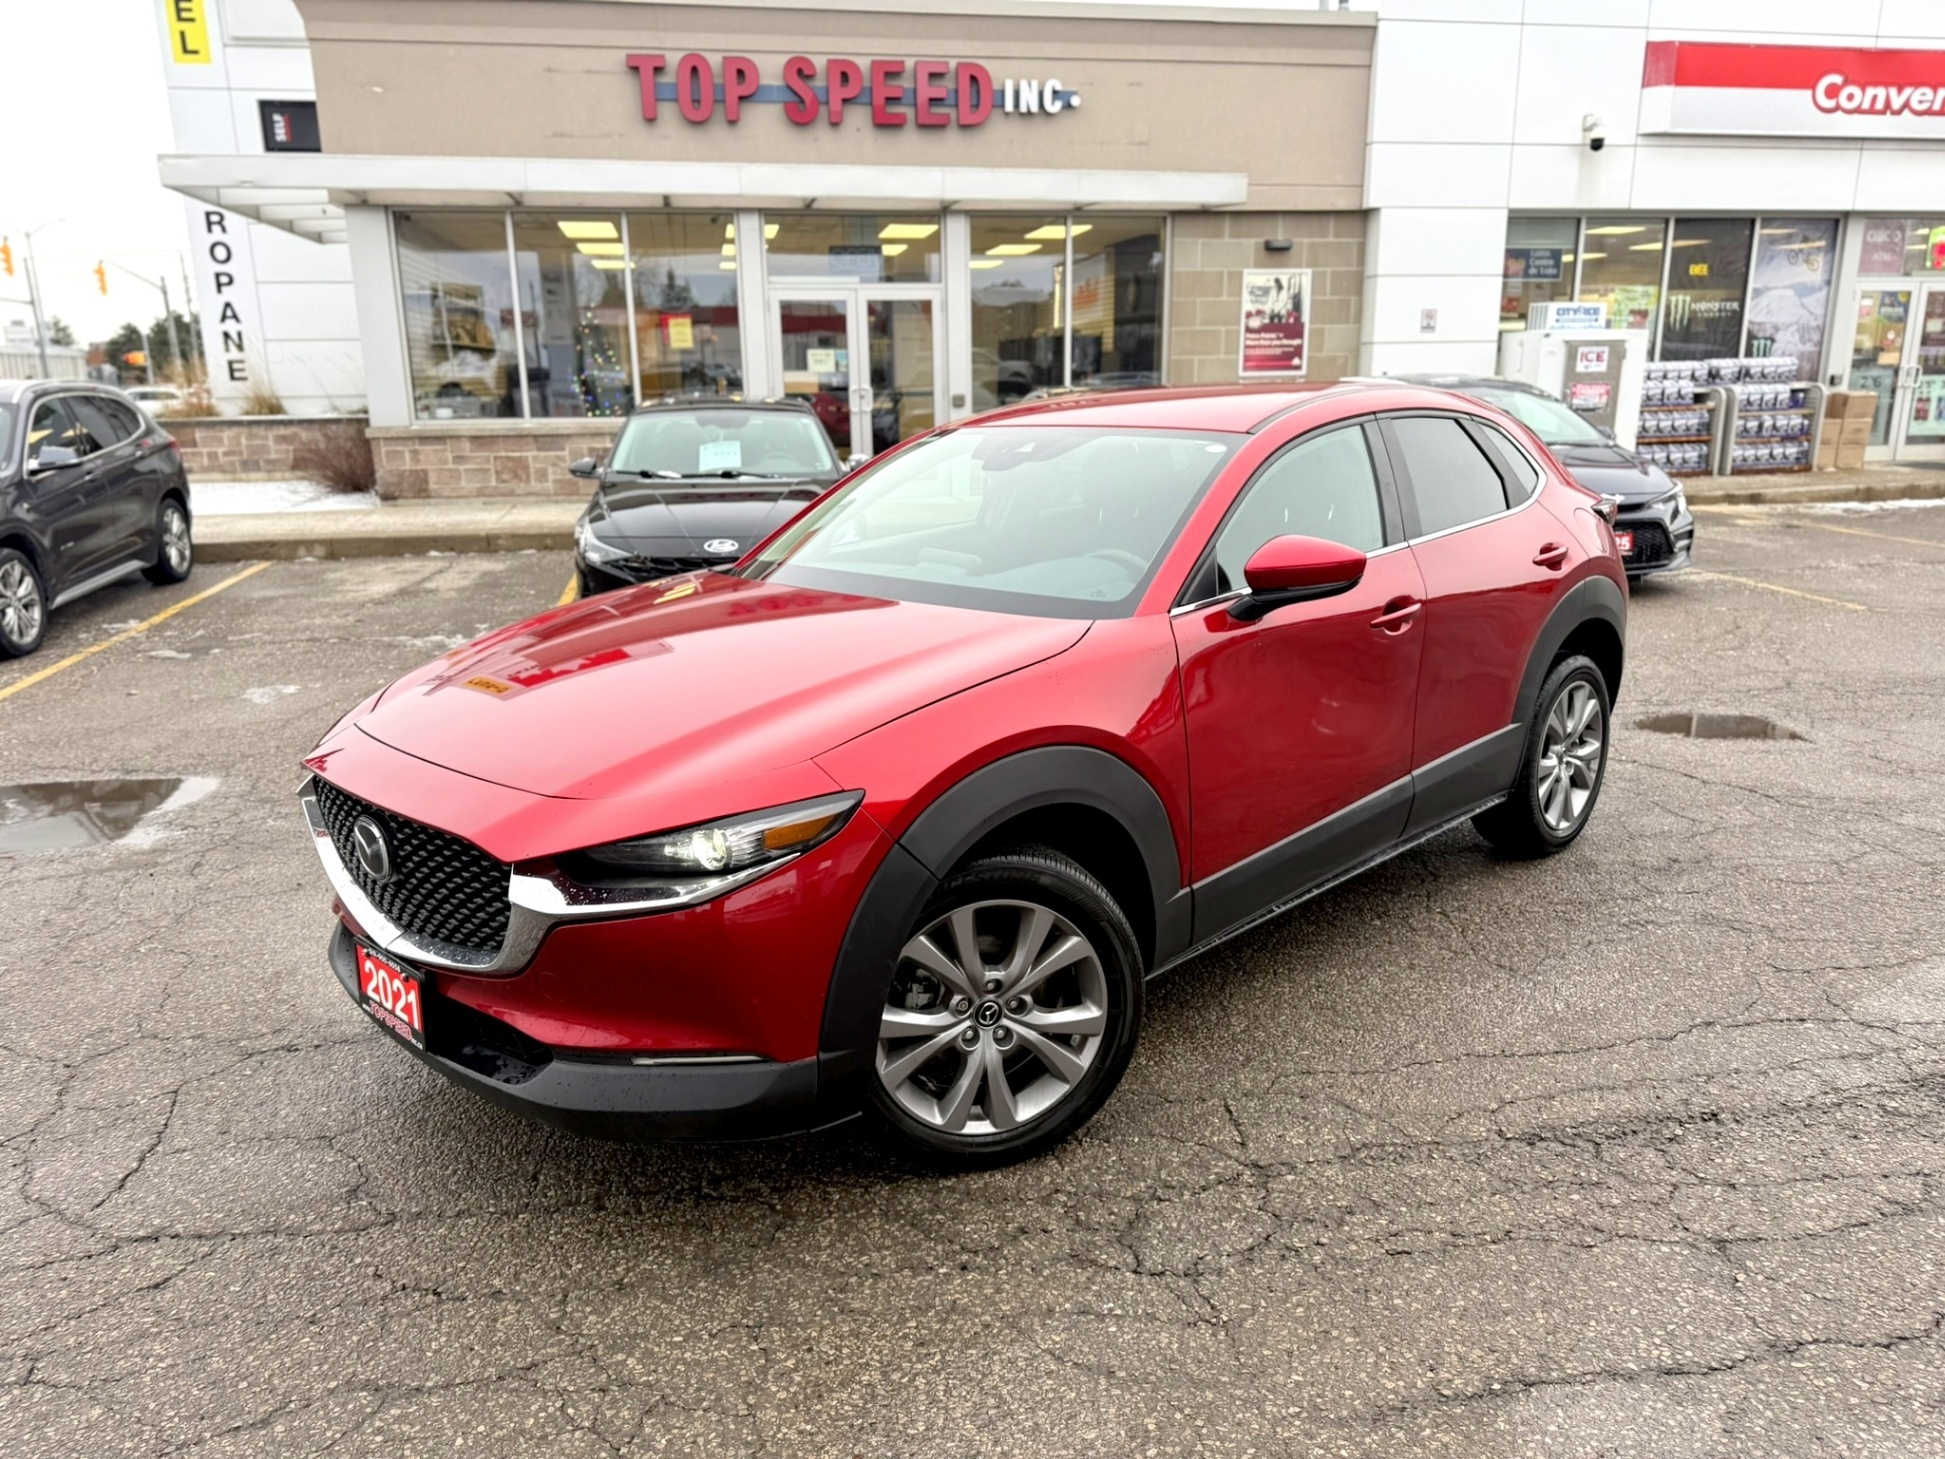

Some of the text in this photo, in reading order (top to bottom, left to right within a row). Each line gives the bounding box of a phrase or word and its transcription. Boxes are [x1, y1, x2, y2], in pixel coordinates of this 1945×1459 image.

[626, 52, 760, 123] TOP
[782, 56, 994, 127] SPEED
[1690, 301, 1740, 311] MONSTER
[1580, 350, 1605, 362] ICE
[364, 959, 420, 1031] 2021
